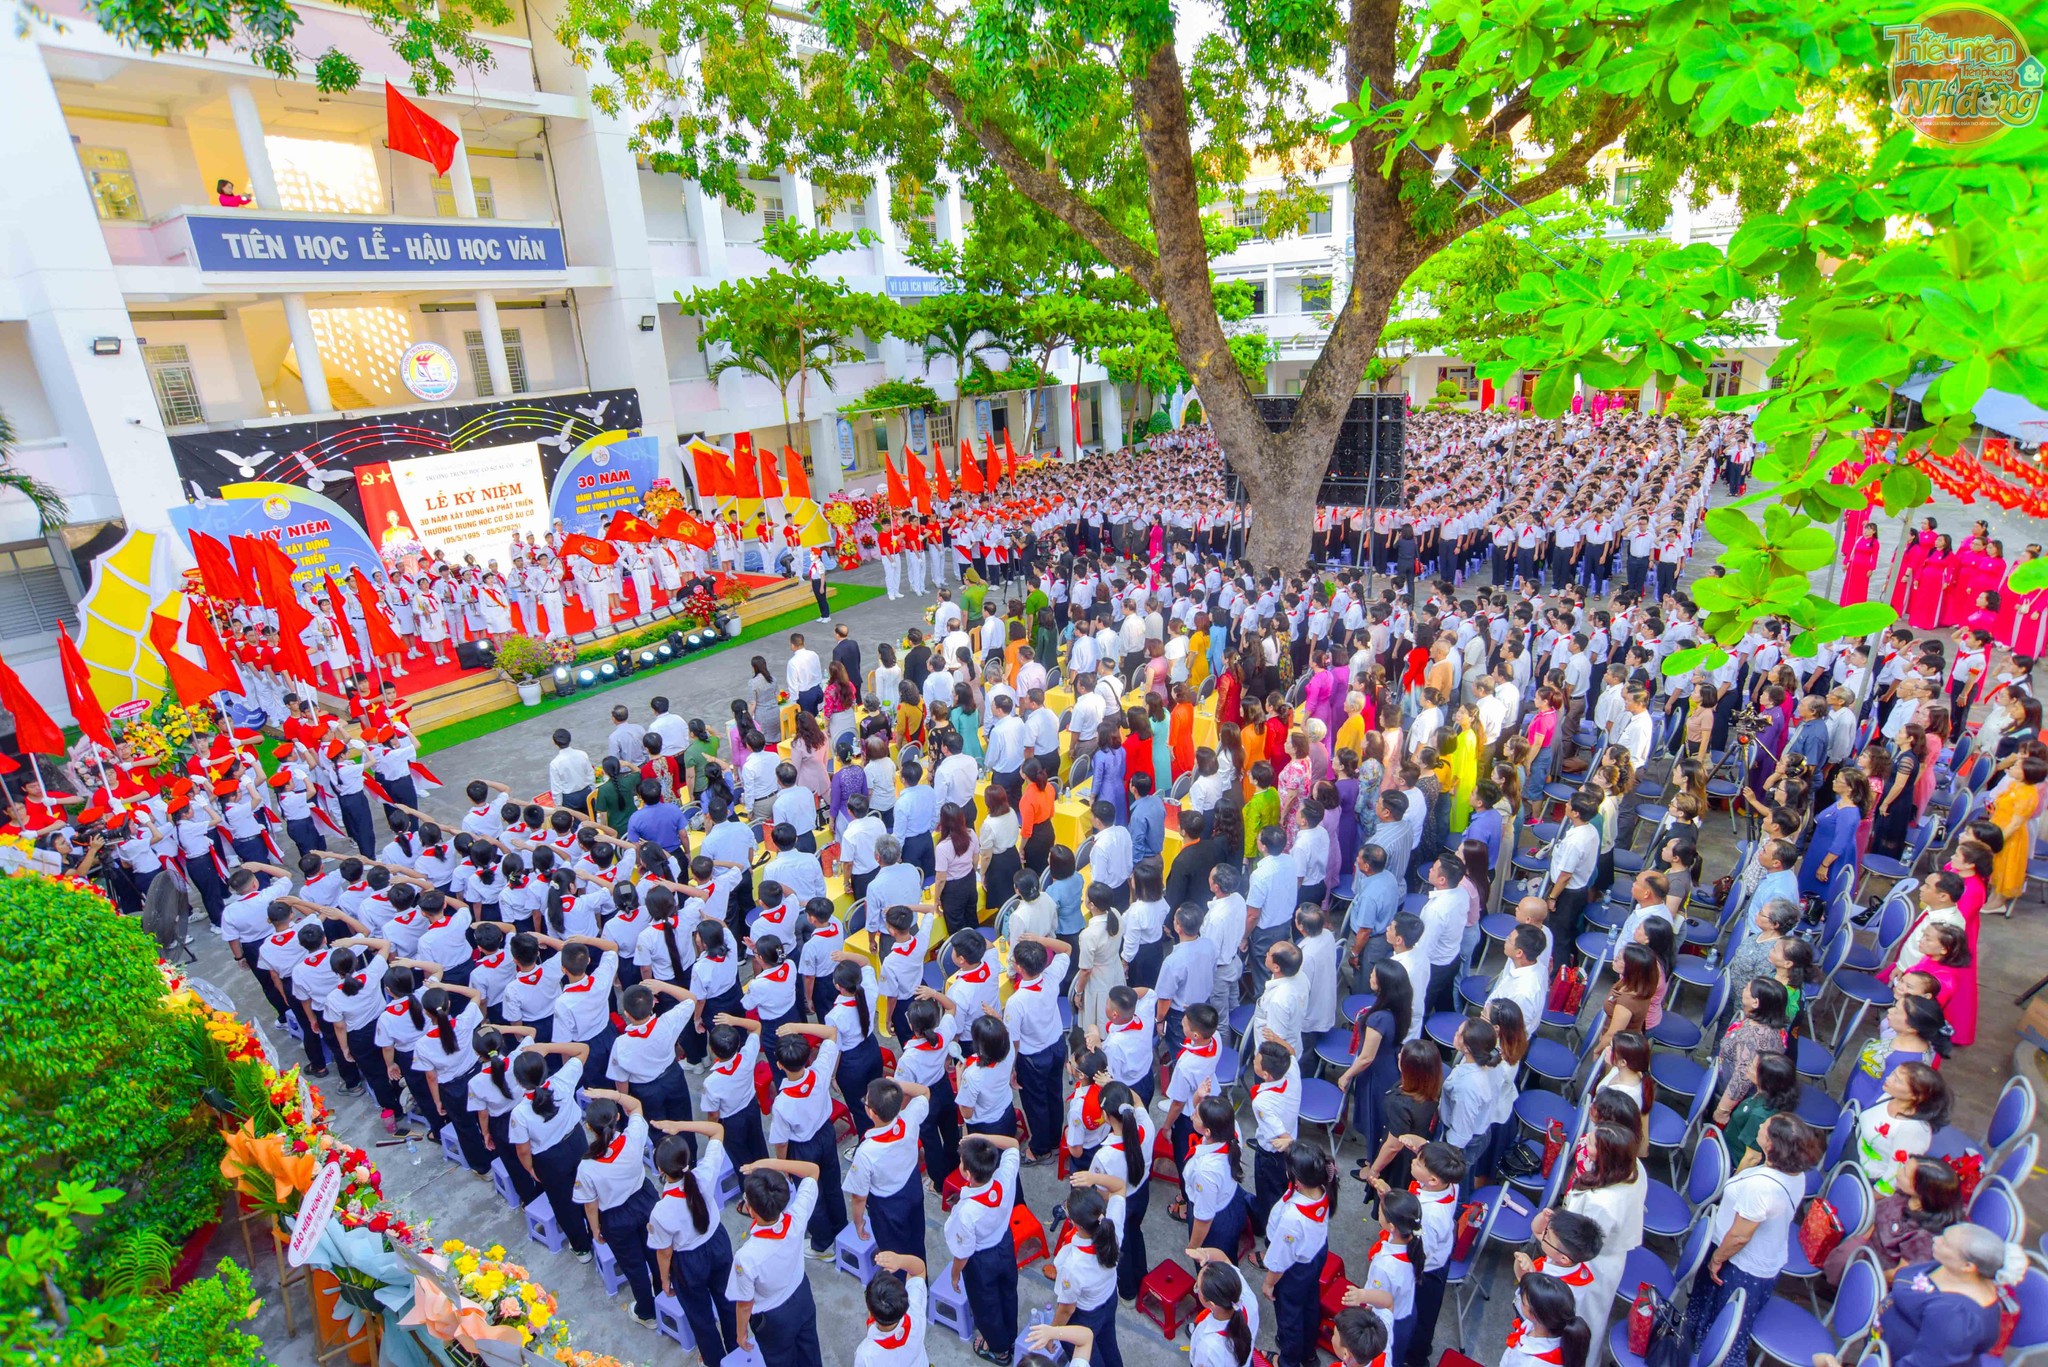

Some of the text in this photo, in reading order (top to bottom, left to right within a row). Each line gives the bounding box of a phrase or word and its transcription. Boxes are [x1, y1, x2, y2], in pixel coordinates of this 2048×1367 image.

[222, 228, 287, 259] TIÊN
[294, 235, 349, 266] HỌC
[358, 226, 390, 260] LỄ
[405, 232, 451, 265] HẬU
[457, 238, 502, 265] HỌC
[506, 235, 546, 260] VĂN
[890, 278, 898, 292] VÌ
[910, 278, 920, 292] ÍCH
[578, 470, 630, 488] 30 NĂM
[426, 482, 523, 510] LỄ KỶ NIỆM
[424, 524, 452, 537] TRƯỜNG
[454, 520, 477, 531] TRUNG
[479, 517, 493, 526] HỌC
[494, 514, 503, 524] CƠ
[526, 508, 534, 517] CƠ
[431, 514, 449, 524] NĂM
[450, 510, 463, 520] XÂY
[466, 508, 484, 518] DỰNG
[486, 504, 495, 513] VÀ
[496, 502, 513, 512] PHÁT
[287, 520, 331, 537] NIỆM
[286, 538, 330, 555] XÂY DỰNG
[328, 564, 341, 575] CƠ
[293, 1232, 305, 1252] BẢO
